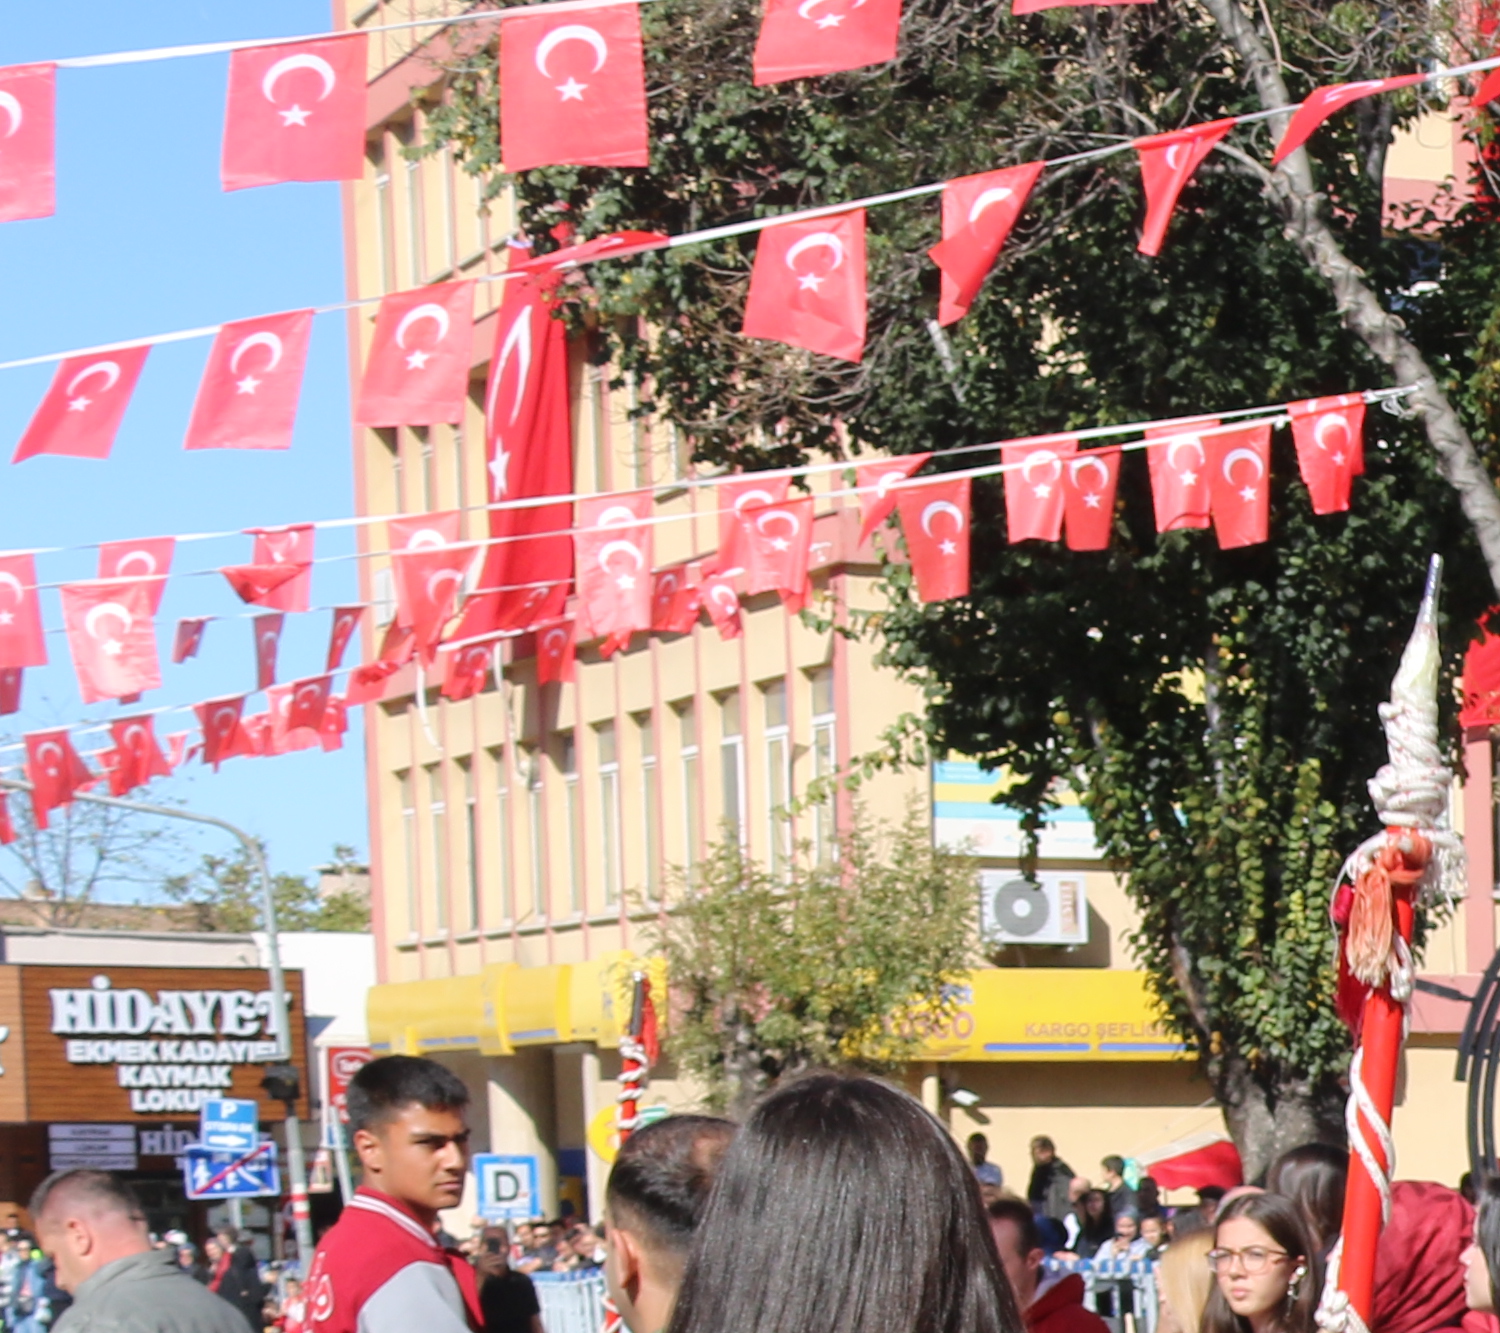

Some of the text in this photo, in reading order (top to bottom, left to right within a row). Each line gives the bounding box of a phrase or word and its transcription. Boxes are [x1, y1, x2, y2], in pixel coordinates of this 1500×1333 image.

[50, 974, 292, 1036] HİDAYET
[1025, 1022, 1091, 1038] KARGO
[67, 1041, 160, 1063] EKMEK
[119, 1065, 233, 1087] KAYMAK
[221, 1101, 237, 1118] P
[494, 1171, 519, 1202] D
